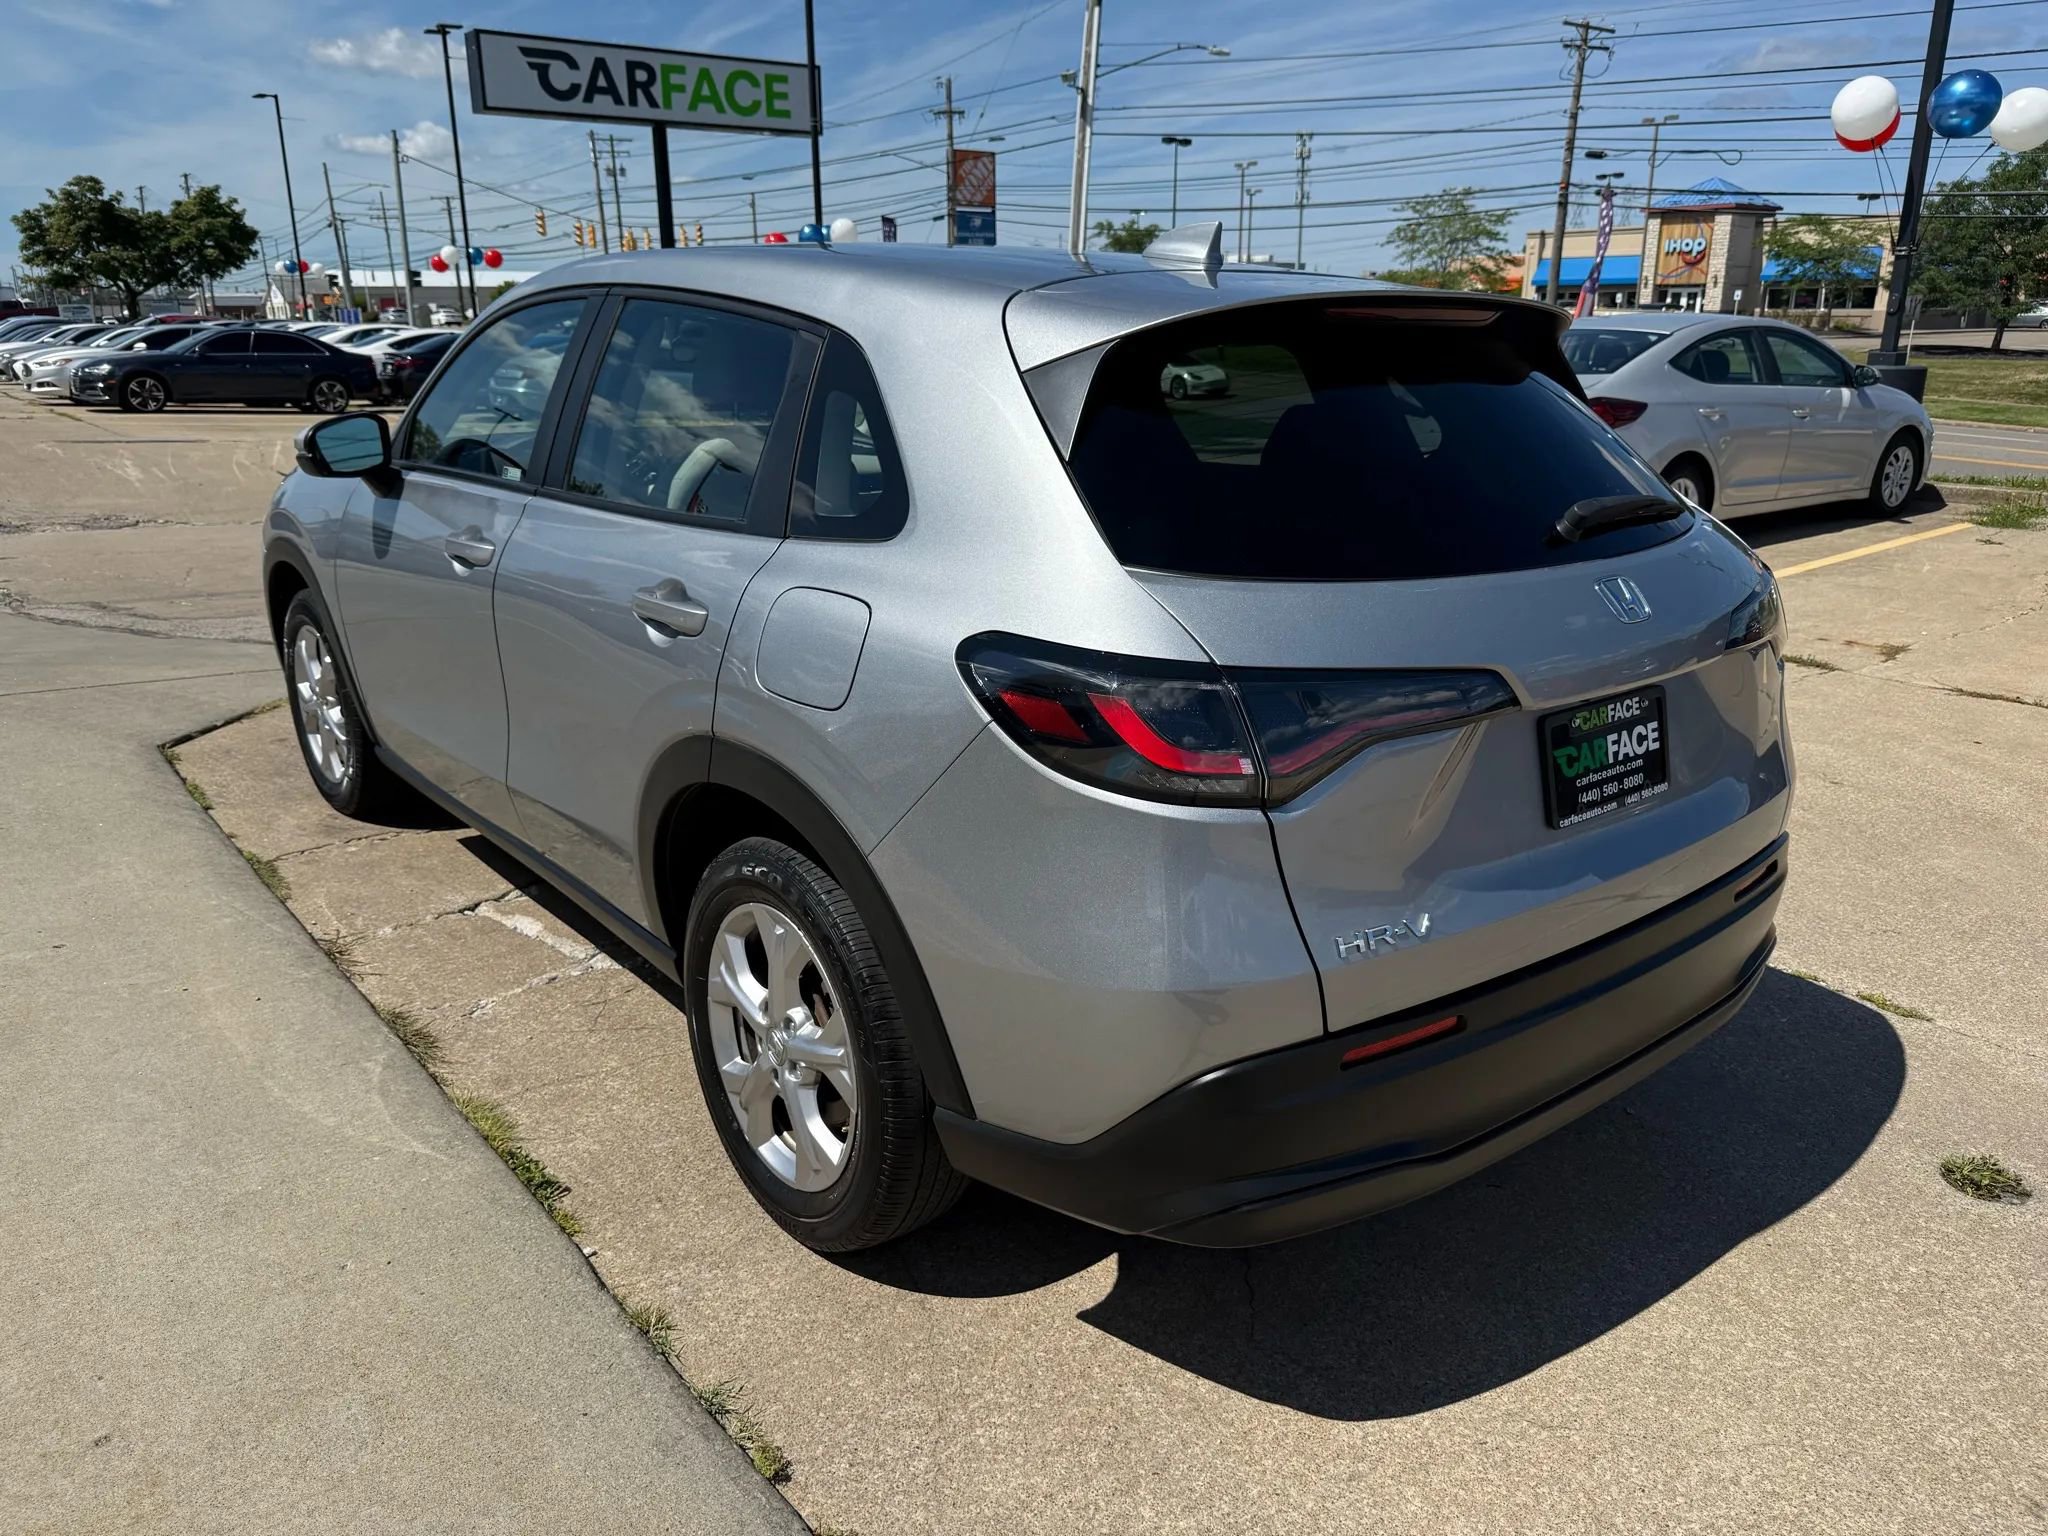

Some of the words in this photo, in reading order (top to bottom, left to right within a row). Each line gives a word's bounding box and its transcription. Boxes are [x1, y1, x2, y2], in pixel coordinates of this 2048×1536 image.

[518, 46, 791, 119] CARFACE
[1664, 237, 1706, 257] IHOP
[1576, 697, 1641, 731] CARFACE
[1552, 721, 1660, 777] CARFACE
[1576, 759, 1644, 787] carfaceauto.com
[1559, 801, 1618, 828] carfaceauto.com
[1624, 792, 1641, 806] (440)
[1641, 782, 1669, 800] 560-8080
[1578, 787, 1601, 804] (440)
[1336, 913, 1430, 958] HR-V
